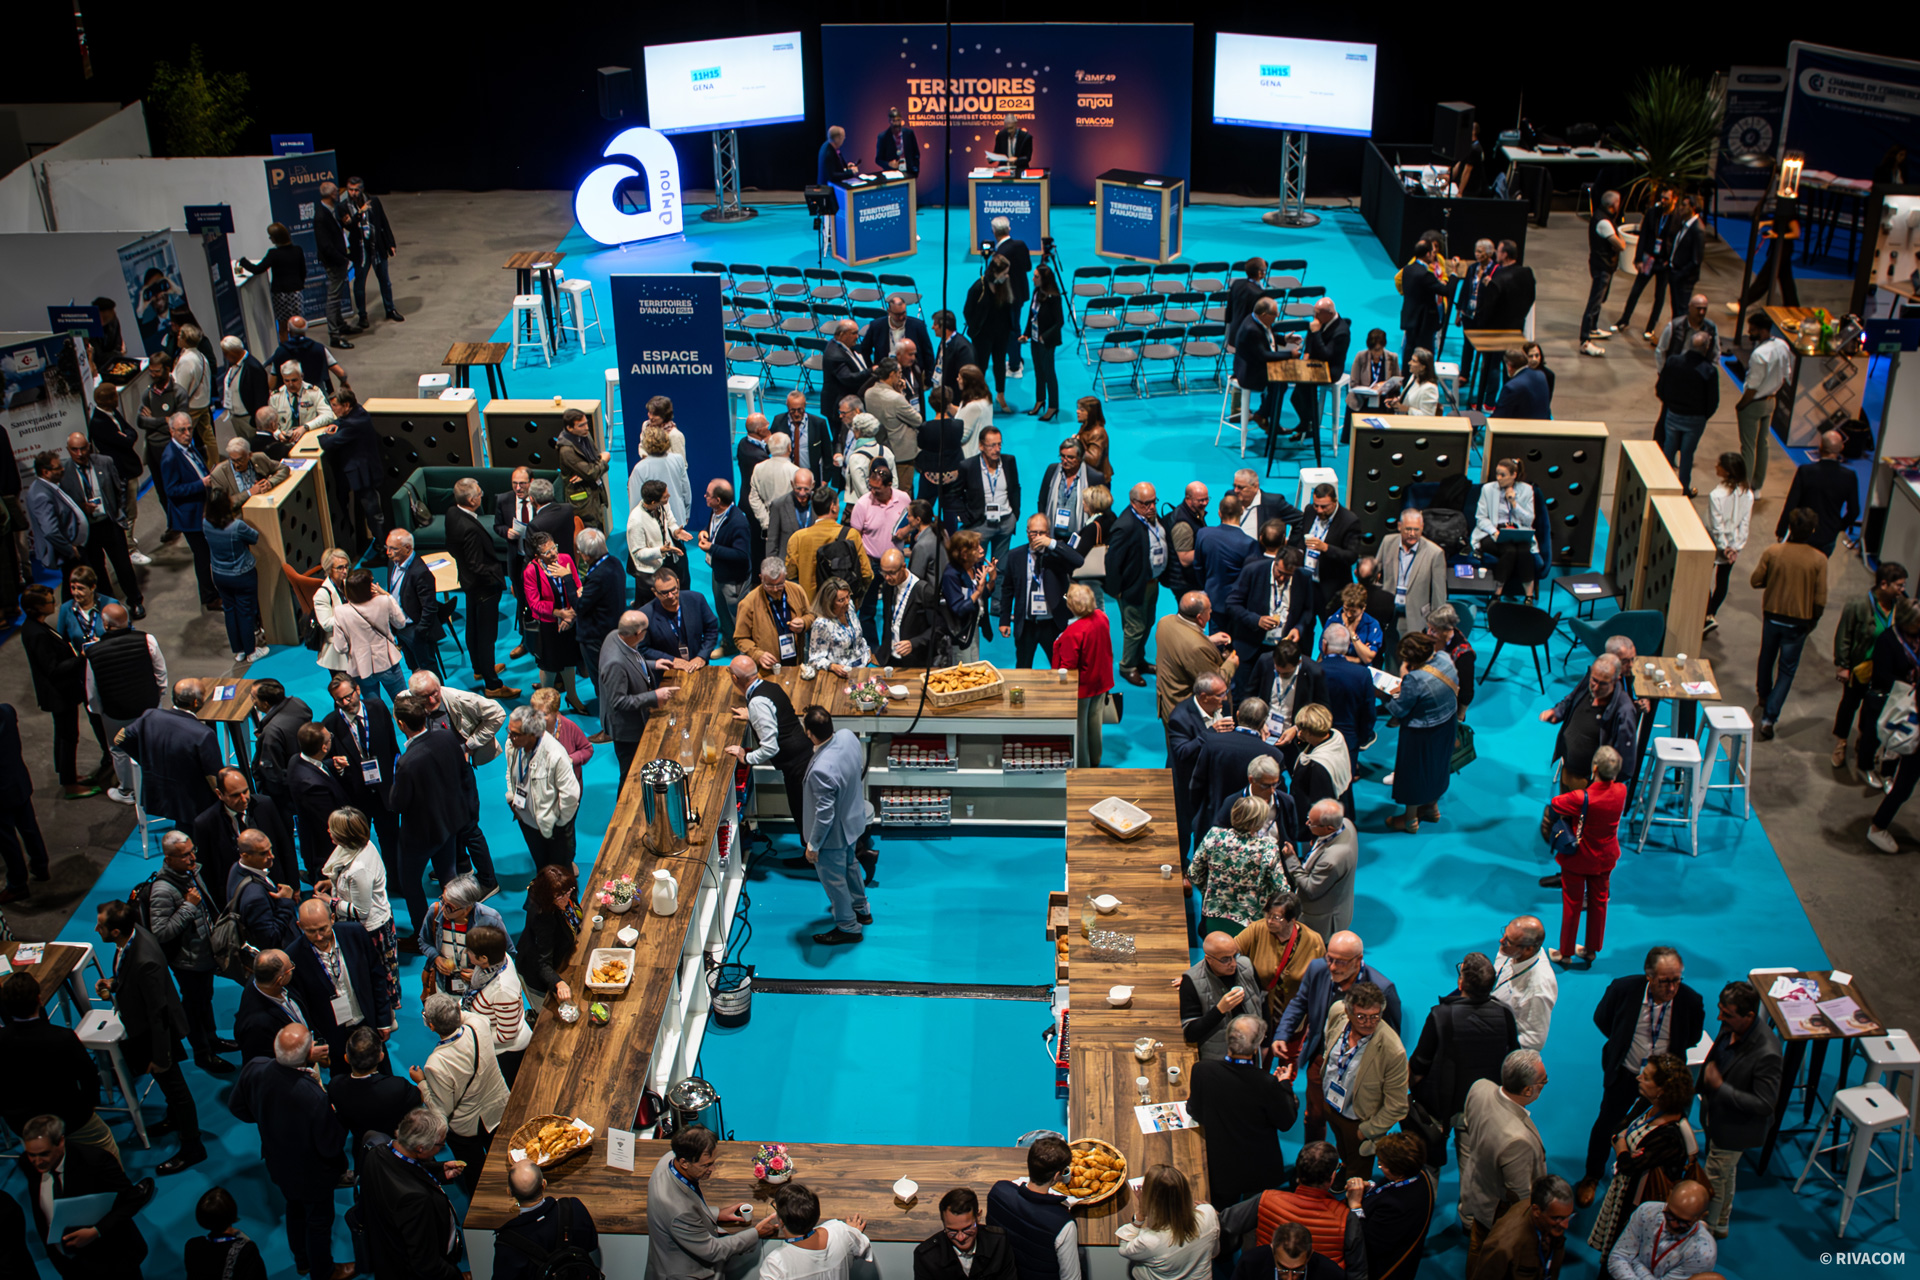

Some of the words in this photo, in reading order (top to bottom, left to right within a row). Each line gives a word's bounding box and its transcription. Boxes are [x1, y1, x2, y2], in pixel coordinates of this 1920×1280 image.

[692, 69, 720, 81] 11H15
[1261, 67, 1289, 77] 11H15
[692, 83, 714, 91] GENA
[906, 78, 1036, 95] TERRITOIRES
[1260, 79, 1282, 87] GENA
[908, 96, 994, 113] D'ANJOU
[998, 99, 1032, 108] 2024
[1077, 97, 1113, 110] anjou
[1076, 117, 1114, 125] RIVACOM
[289, 170, 335, 186] PUBLICA
[639, 299, 693, 307] TERRITOIRES
[639, 306, 675, 315] D'ANJOU
[643, 350, 699, 362] ESPACE
[630, 364, 713, 375] ANIMATION
[10, 412, 58, 430] Sauvegarder
[59, 410, 67, 418] le
[18, 420, 62, 438] patrimoine
